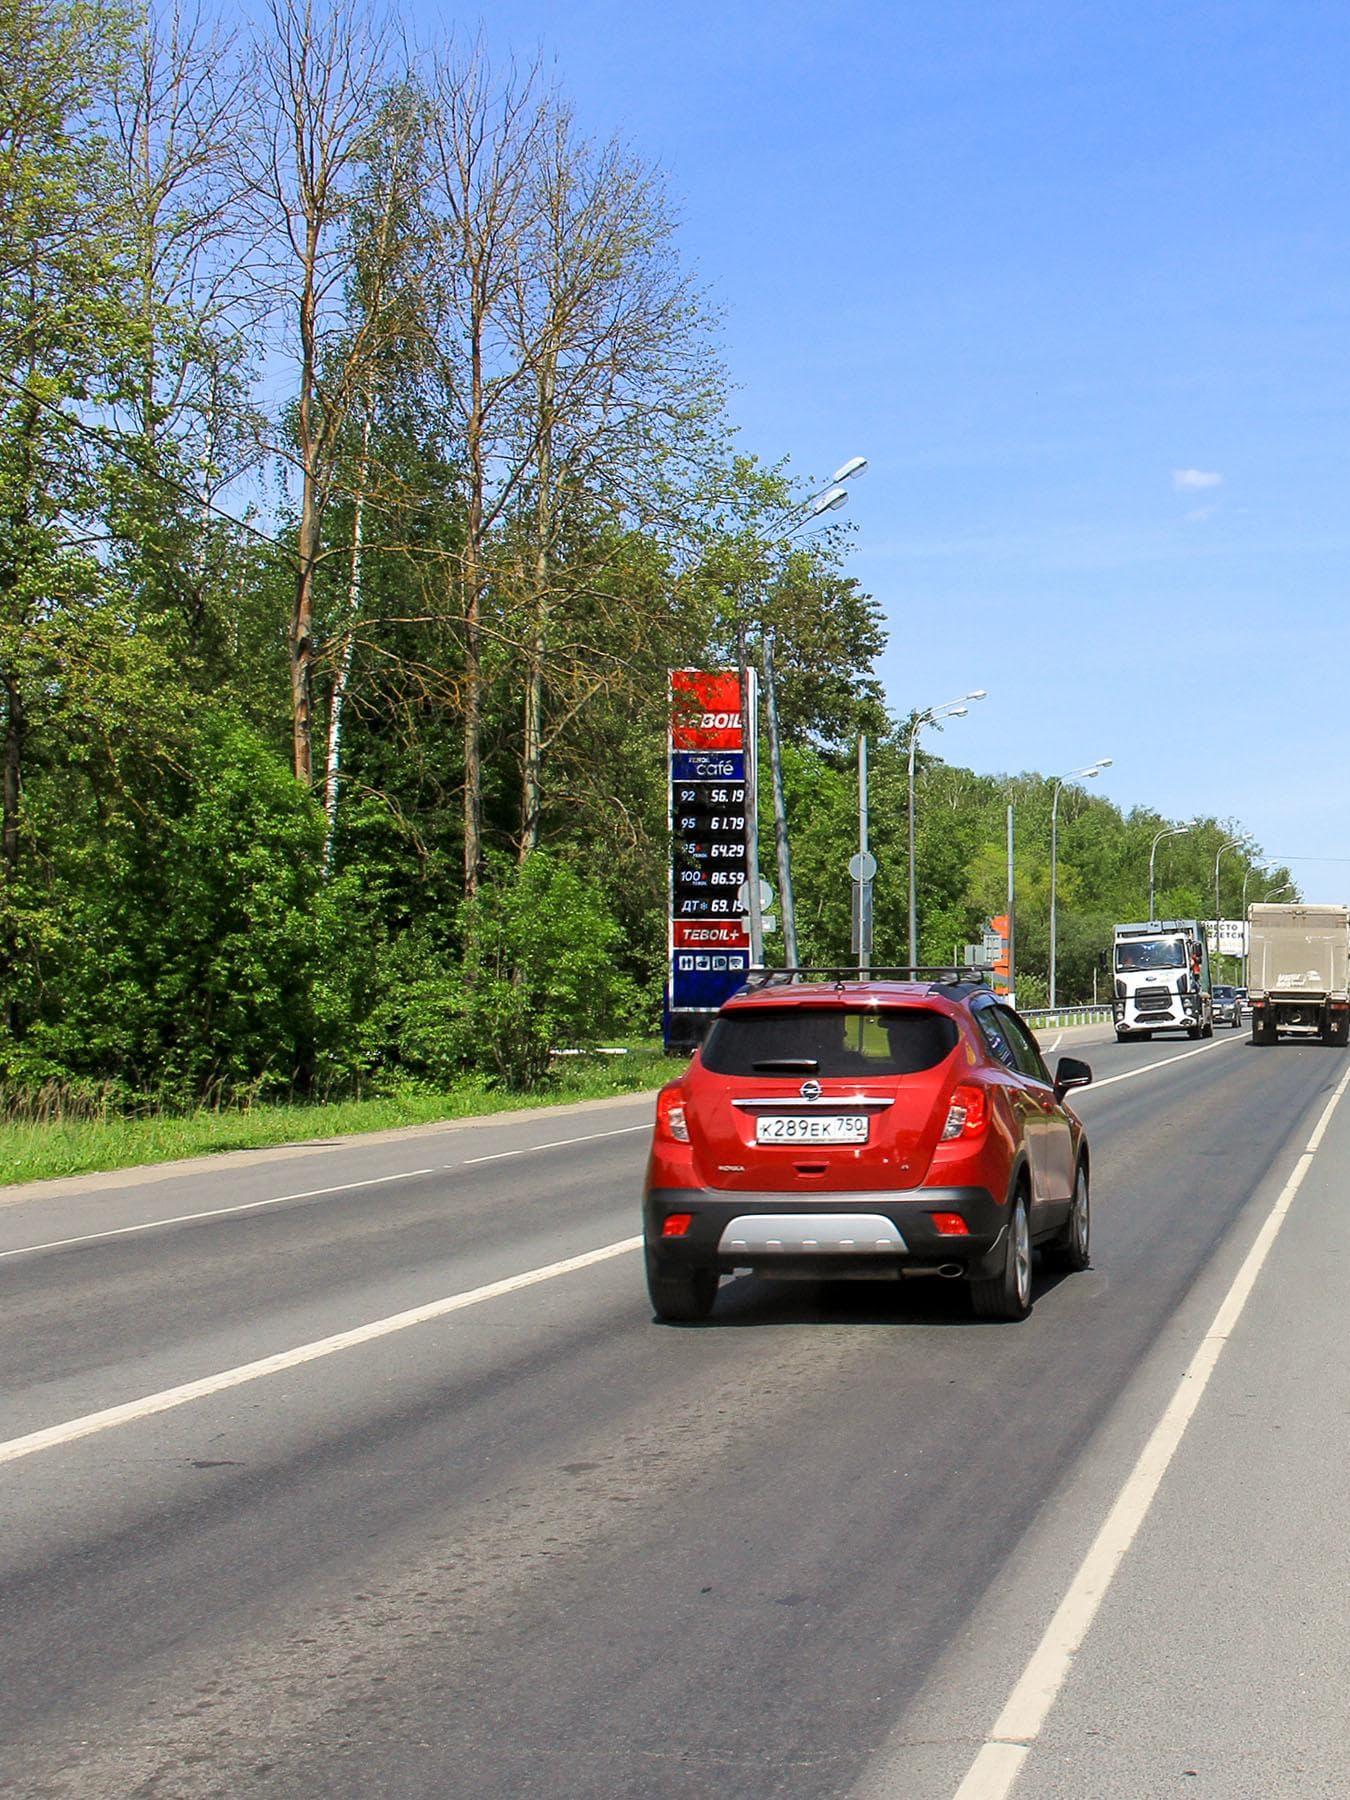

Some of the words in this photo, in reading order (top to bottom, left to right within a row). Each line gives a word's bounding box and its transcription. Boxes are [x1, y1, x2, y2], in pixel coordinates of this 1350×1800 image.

[696, 760, 734, 775] café
[681, 790, 696, 801] 92
[711, 789, 744, 802] 56.19
[681, 818, 696, 828] 95
[711, 817, 744, 829] 61.79
[711, 845, 744, 857] 64.29
[681, 871, 701, 881] 100
[711, 872, 745, 884] 86.59
[682, 900, 699, 912] ДТ
[837, 1118, 864, 1131] 750
